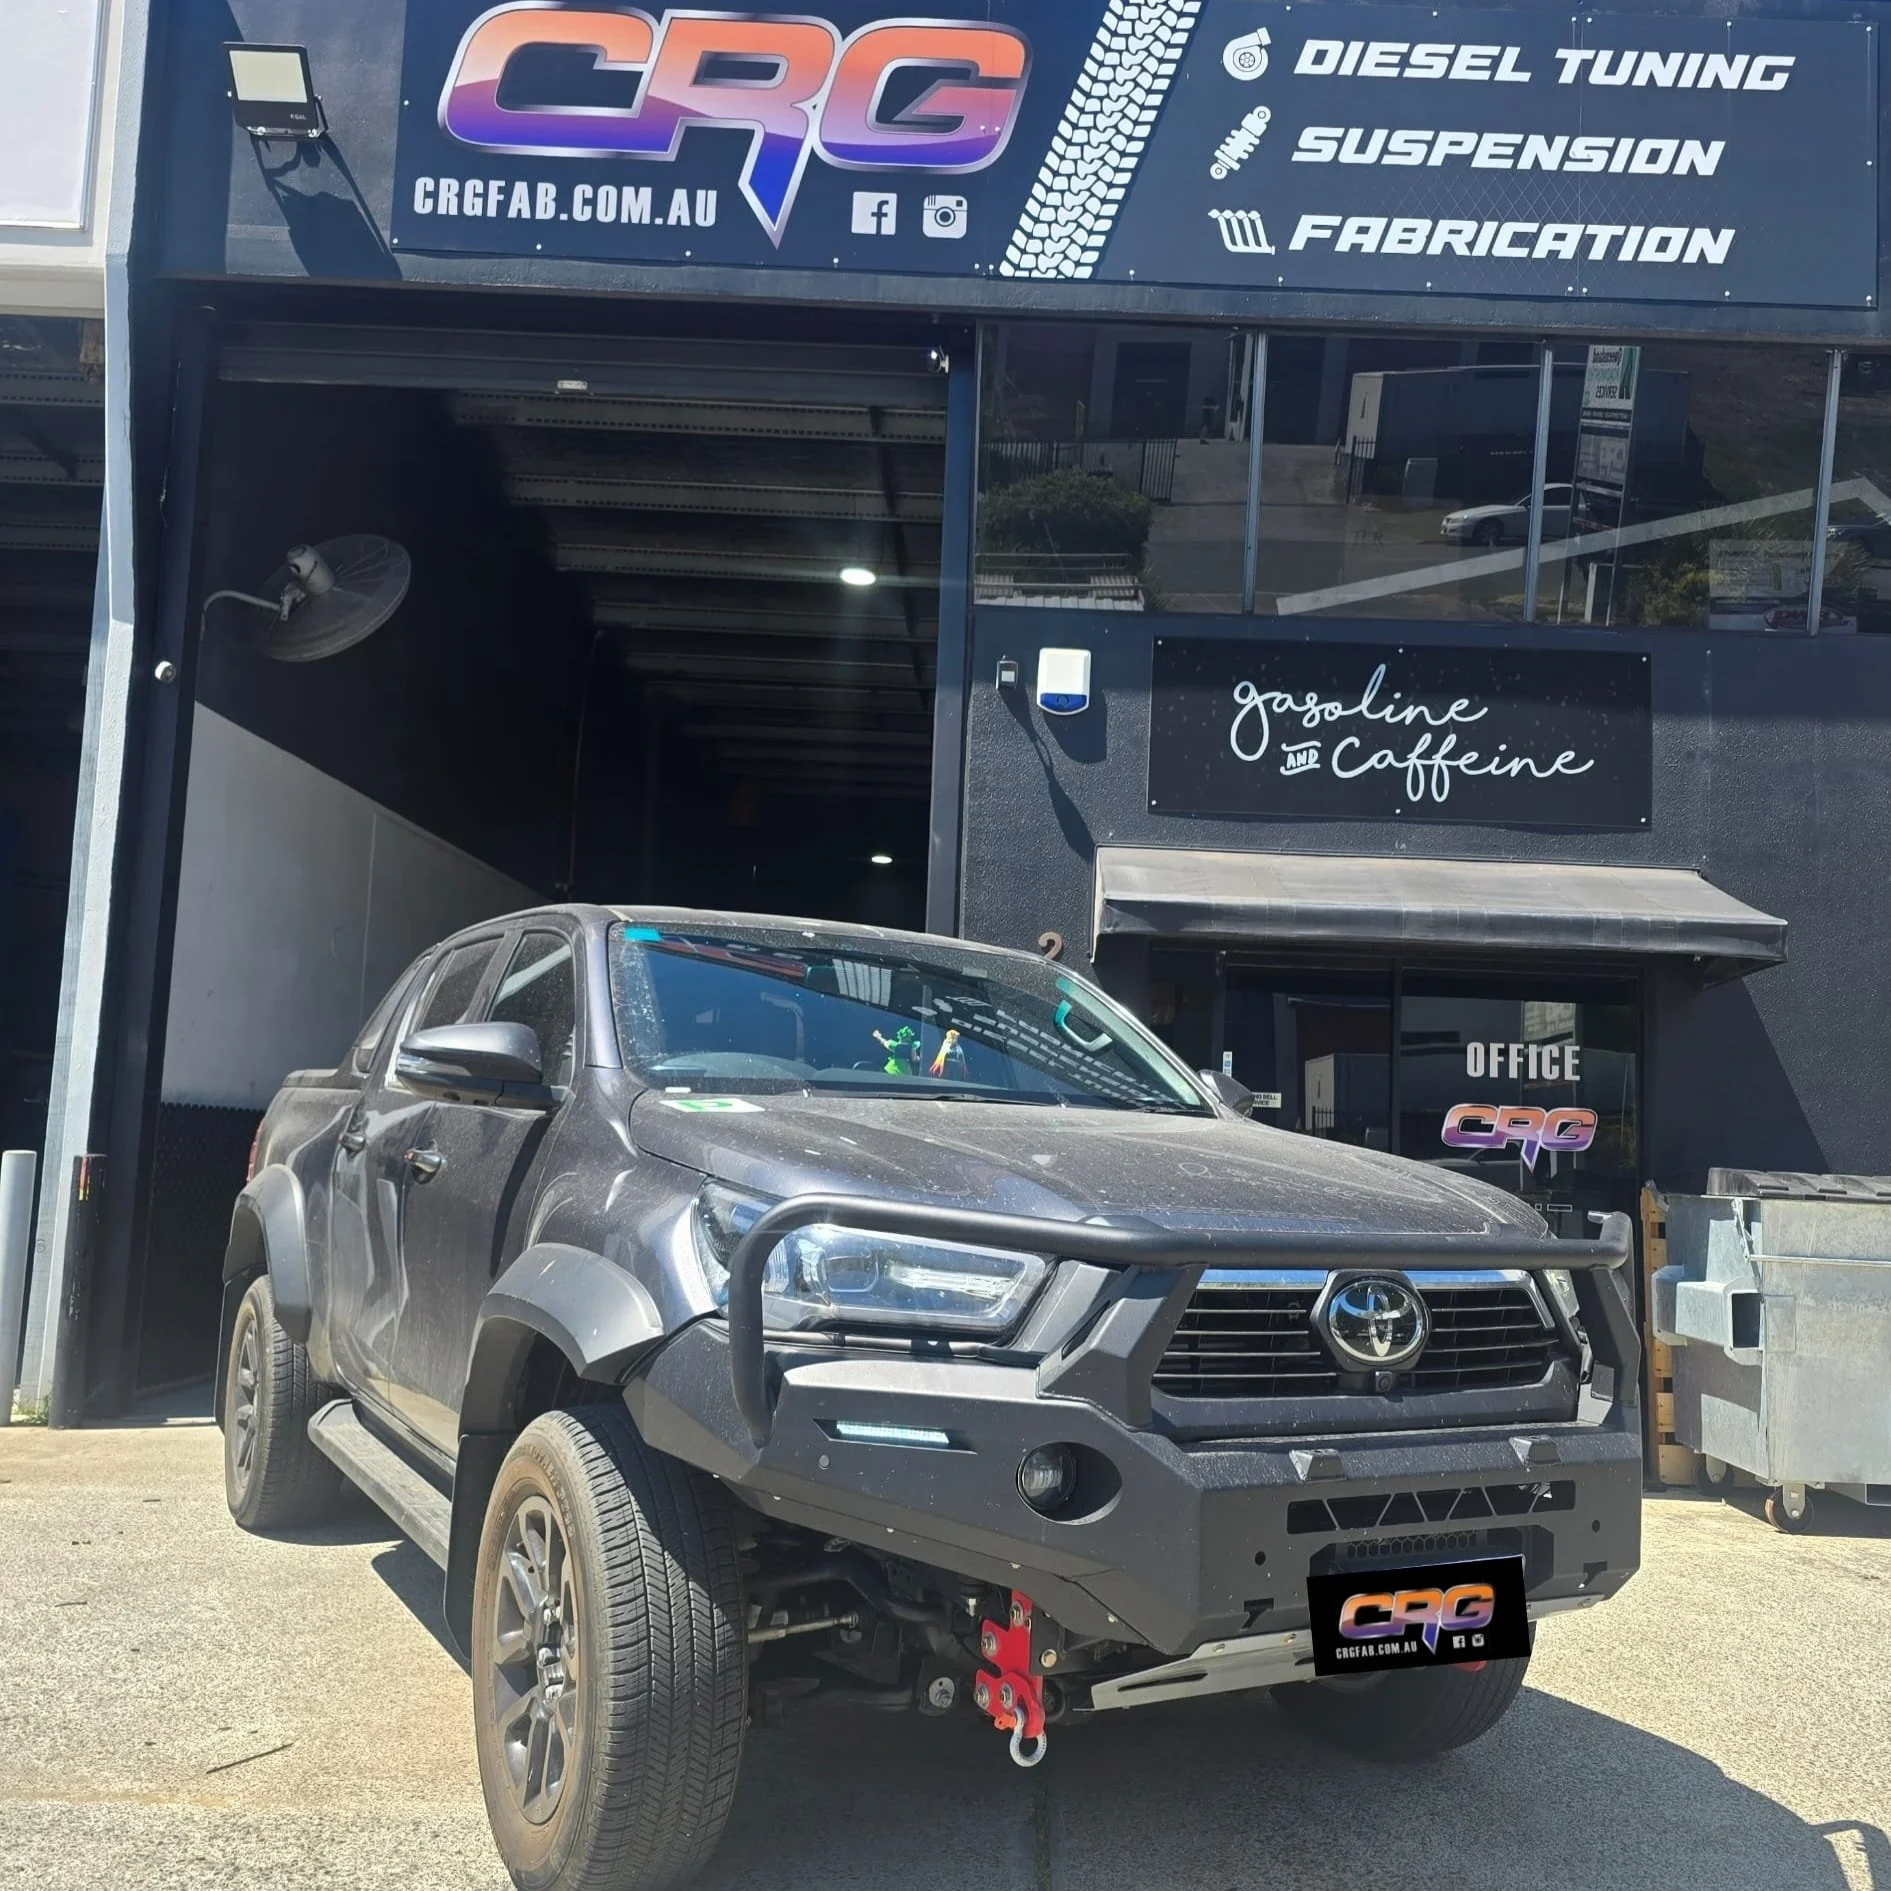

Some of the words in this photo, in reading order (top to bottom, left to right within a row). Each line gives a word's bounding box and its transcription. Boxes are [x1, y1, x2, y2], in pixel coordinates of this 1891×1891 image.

[1293, 38, 1533, 84] DIESEL
[1553, 47, 1796, 92] TUNING
[437, 0, 1032, 249] CRG
[1291, 126, 1726, 177] SUSPENSION
[413, 176, 718, 228] CRGFAB.COM.AU
[1288, 213, 1736, 265] FABRICATION
[1230, 663, 1488, 761] gasoline
[1285, 747, 1319, 769] AND
[1466, 1041, 1581, 1081] OFFICE
[1441, 1103, 1599, 1175] CRG
